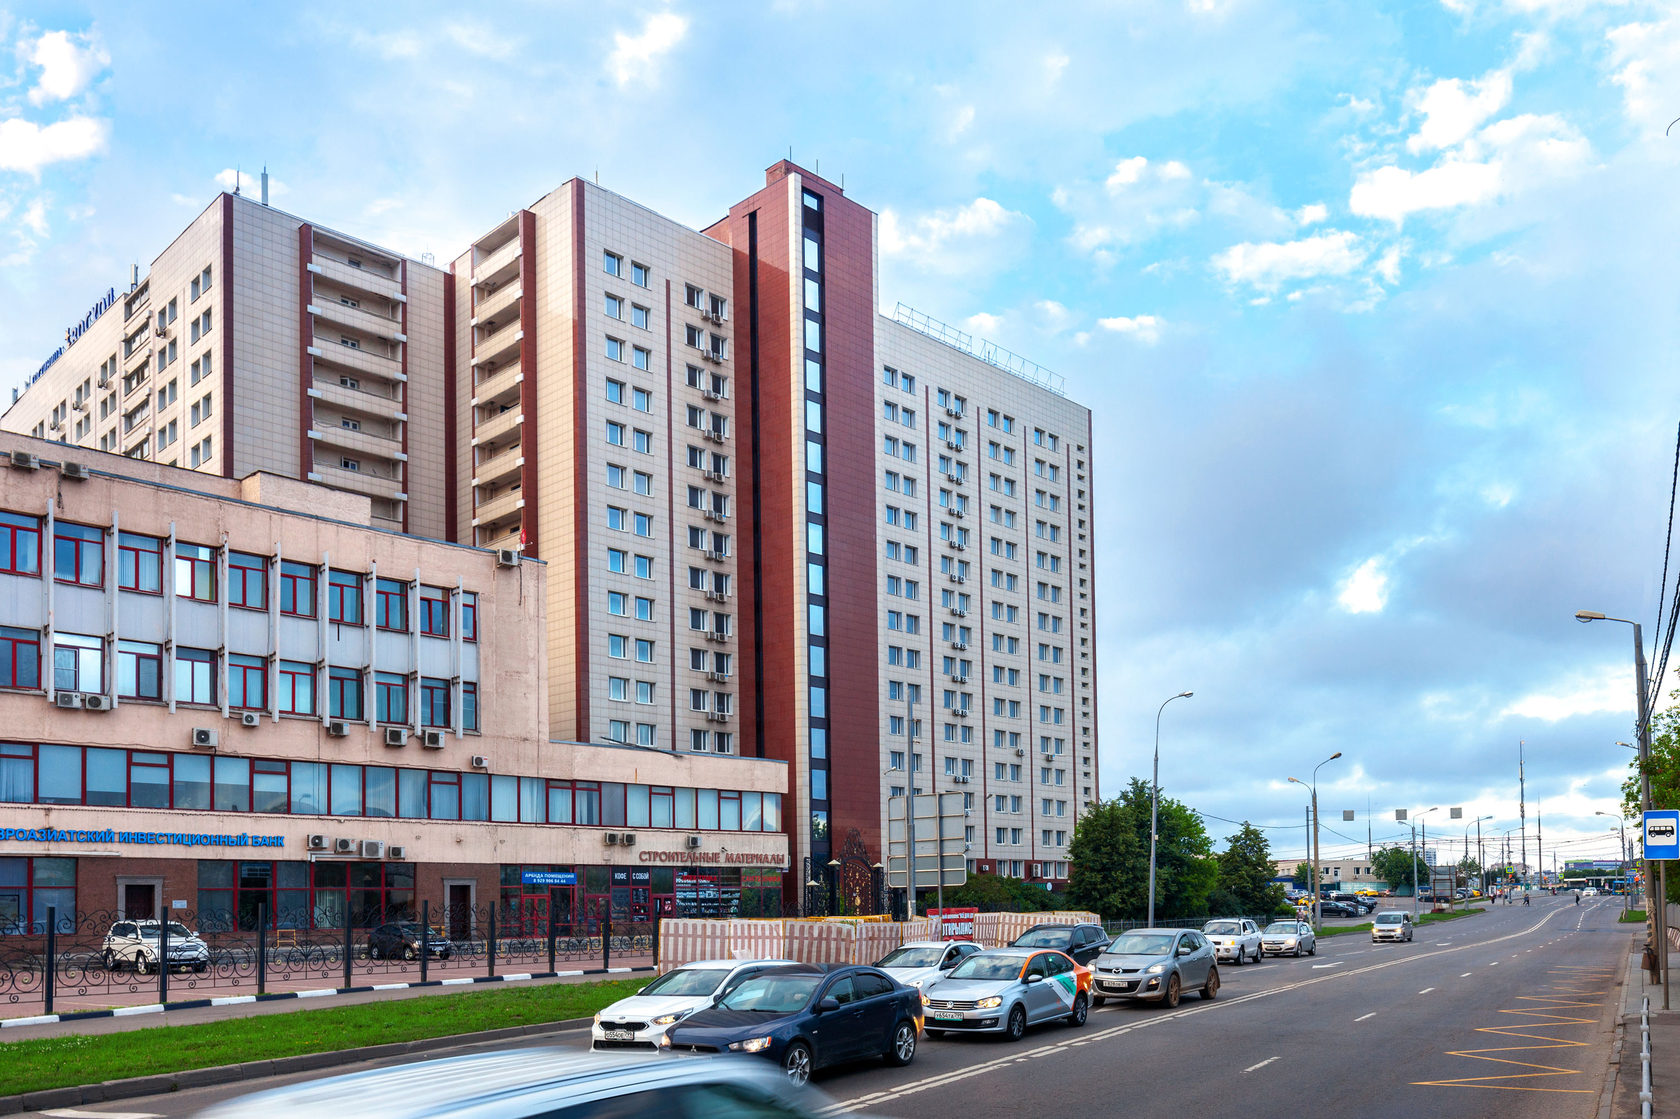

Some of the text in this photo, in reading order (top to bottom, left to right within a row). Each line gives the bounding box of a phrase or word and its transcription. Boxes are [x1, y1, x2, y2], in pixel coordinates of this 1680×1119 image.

[119, 831, 249, 847] ИНВЕСТИЦИОННЫЙ
[252, 835, 285, 847] БАНК
[639, 850, 785, 864] СТРОИТЕЛЬНЫЕ МАТЕРИАЛЫ
[614, 872, 627, 880] КОФЕ
[636, 872, 649, 880] СОБОЙ
